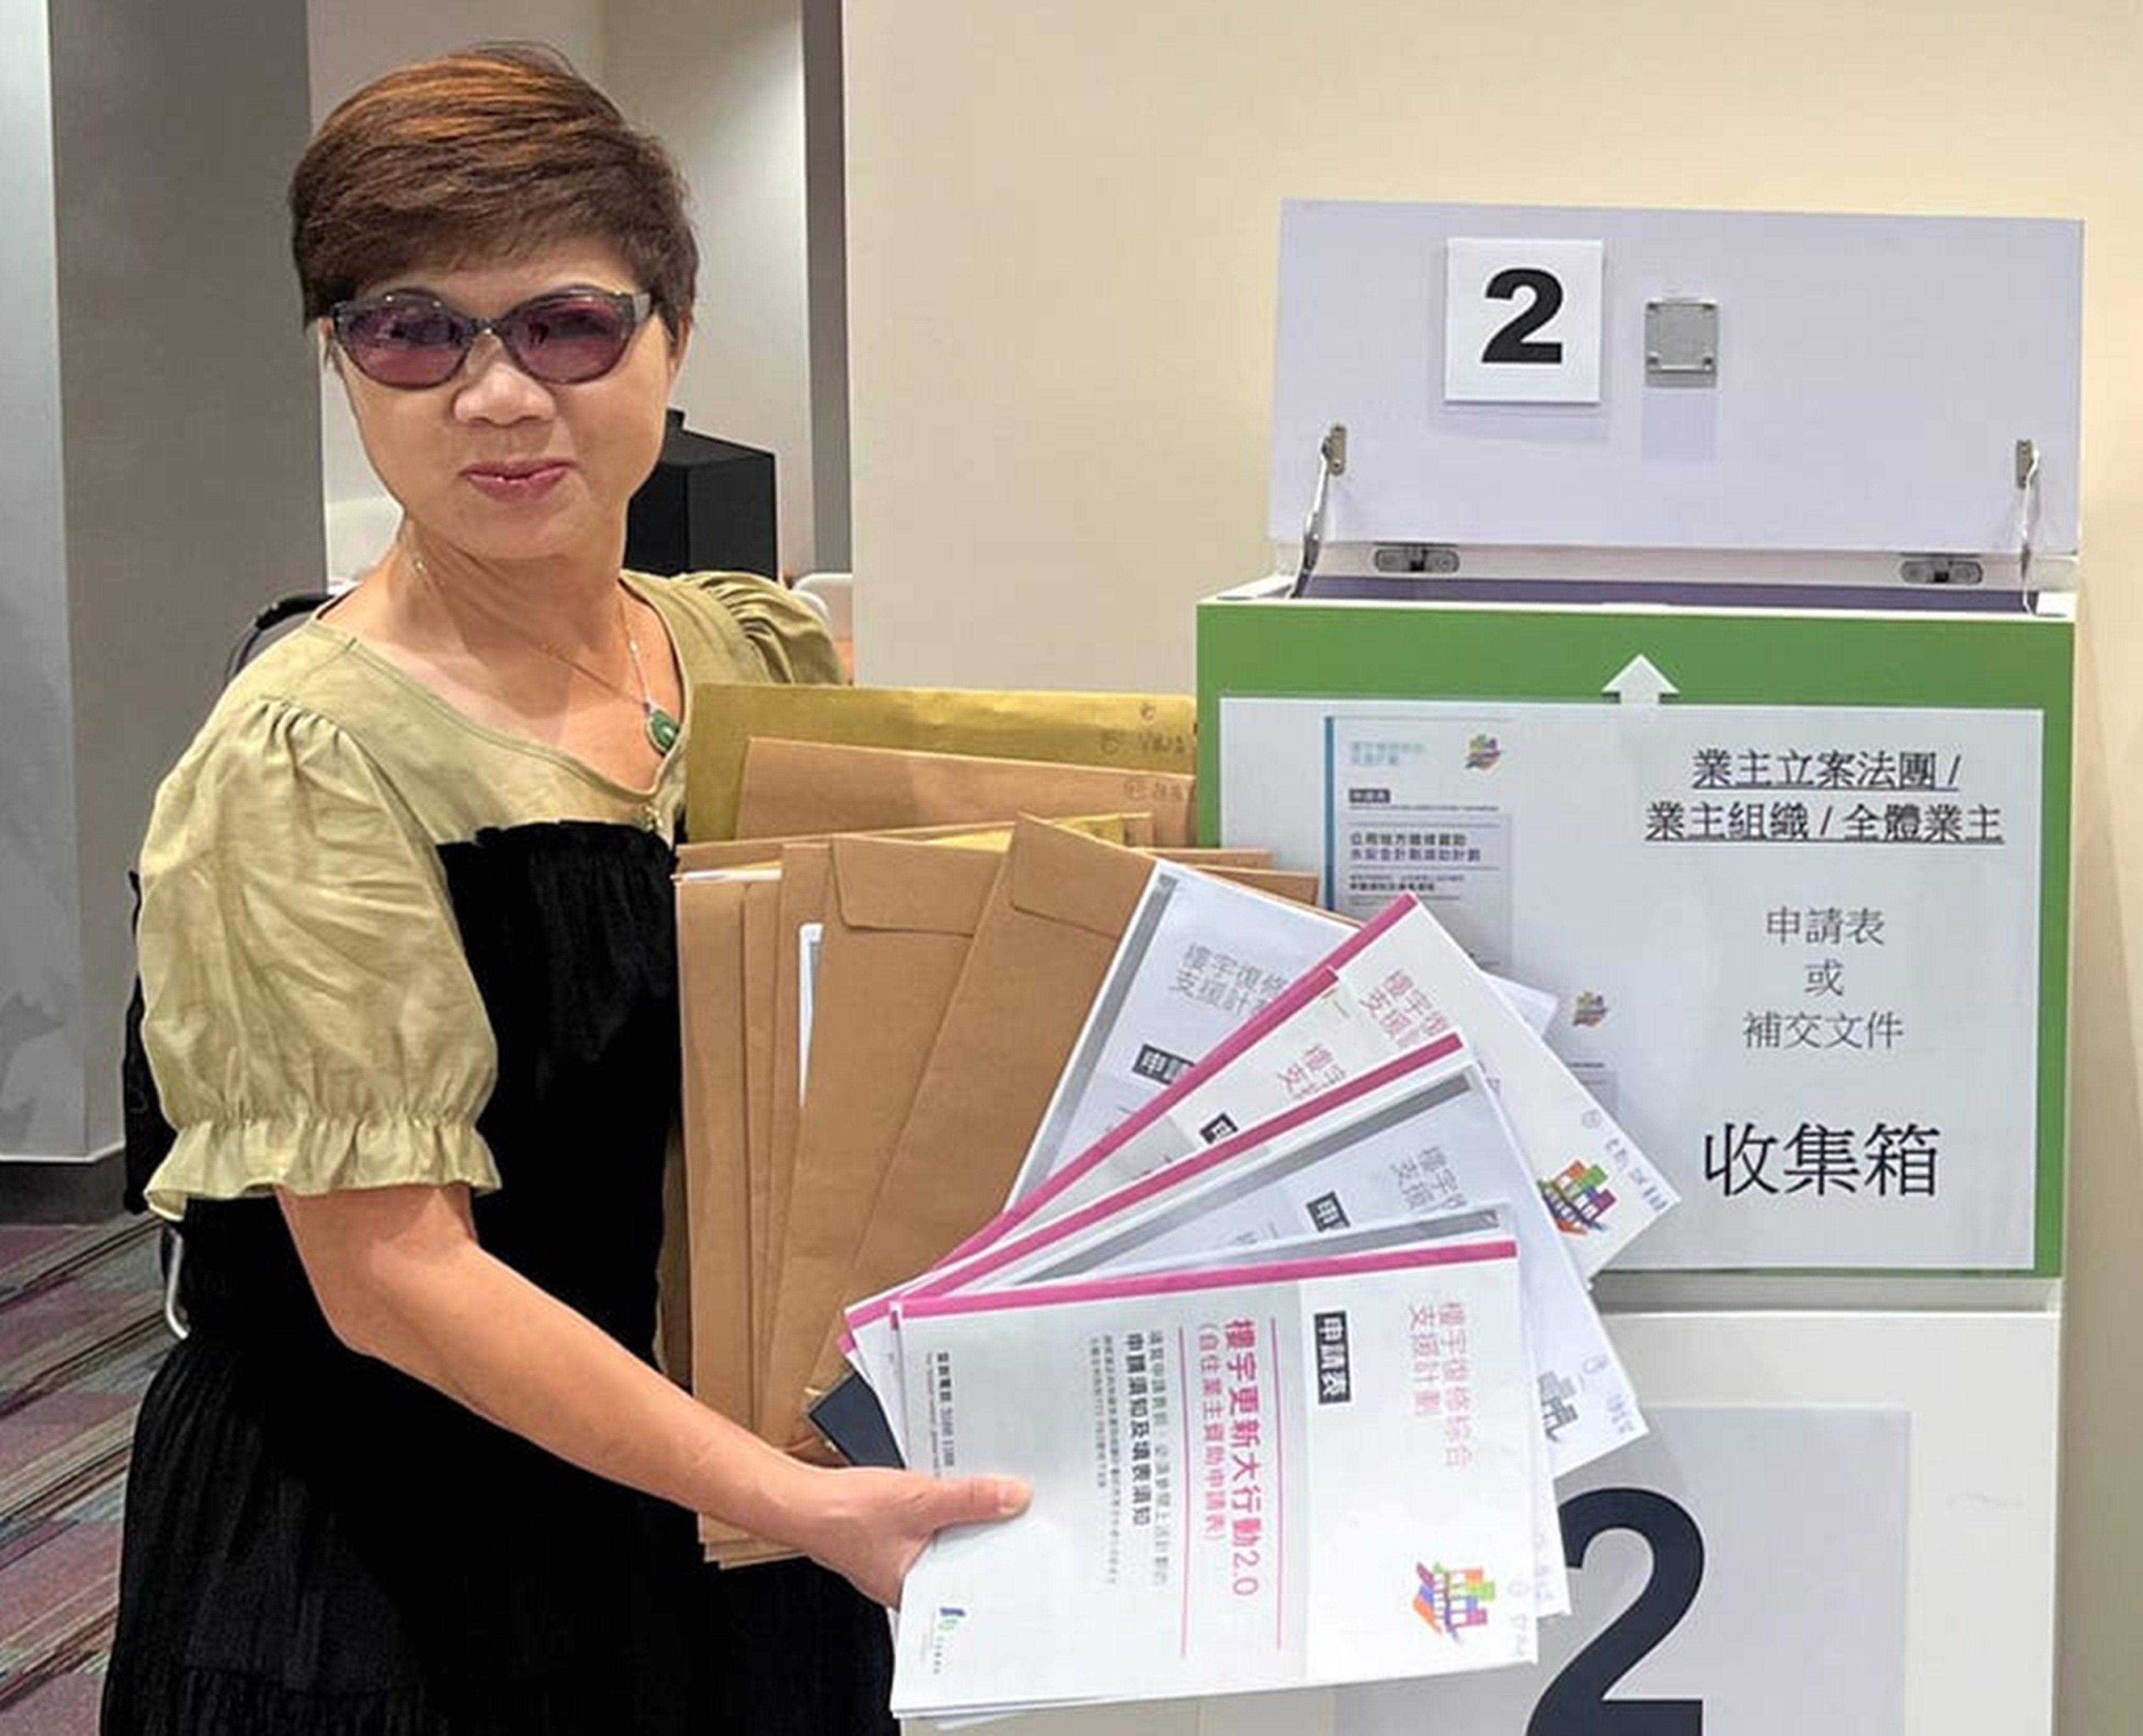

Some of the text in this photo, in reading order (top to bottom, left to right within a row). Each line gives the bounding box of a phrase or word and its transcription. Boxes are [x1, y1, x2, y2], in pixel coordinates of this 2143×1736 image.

[1481, 267, 1563, 364] 2
[1692, 749, 1936, 788] 業主立案法團
[1646, 801, 1808, 839] 業主組織
[1844, 804, 2004, 842] 全體業主
[1766, 906, 1885, 945] 申請表
[1804, 959, 1845, 996] 或
[1743, 1011, 1905, 1049] 補交文件
[1703, 1122, 1940, 1197] 收集箱
[1319, 1316, 1349, 1400] 申請表
[1409, 1305, 1442, 1416] 支援計劃
[1225, 1317, 1262, 1597] 樓宇更新大行動2.0
[1525, 1487, 1705, 1736] 2
